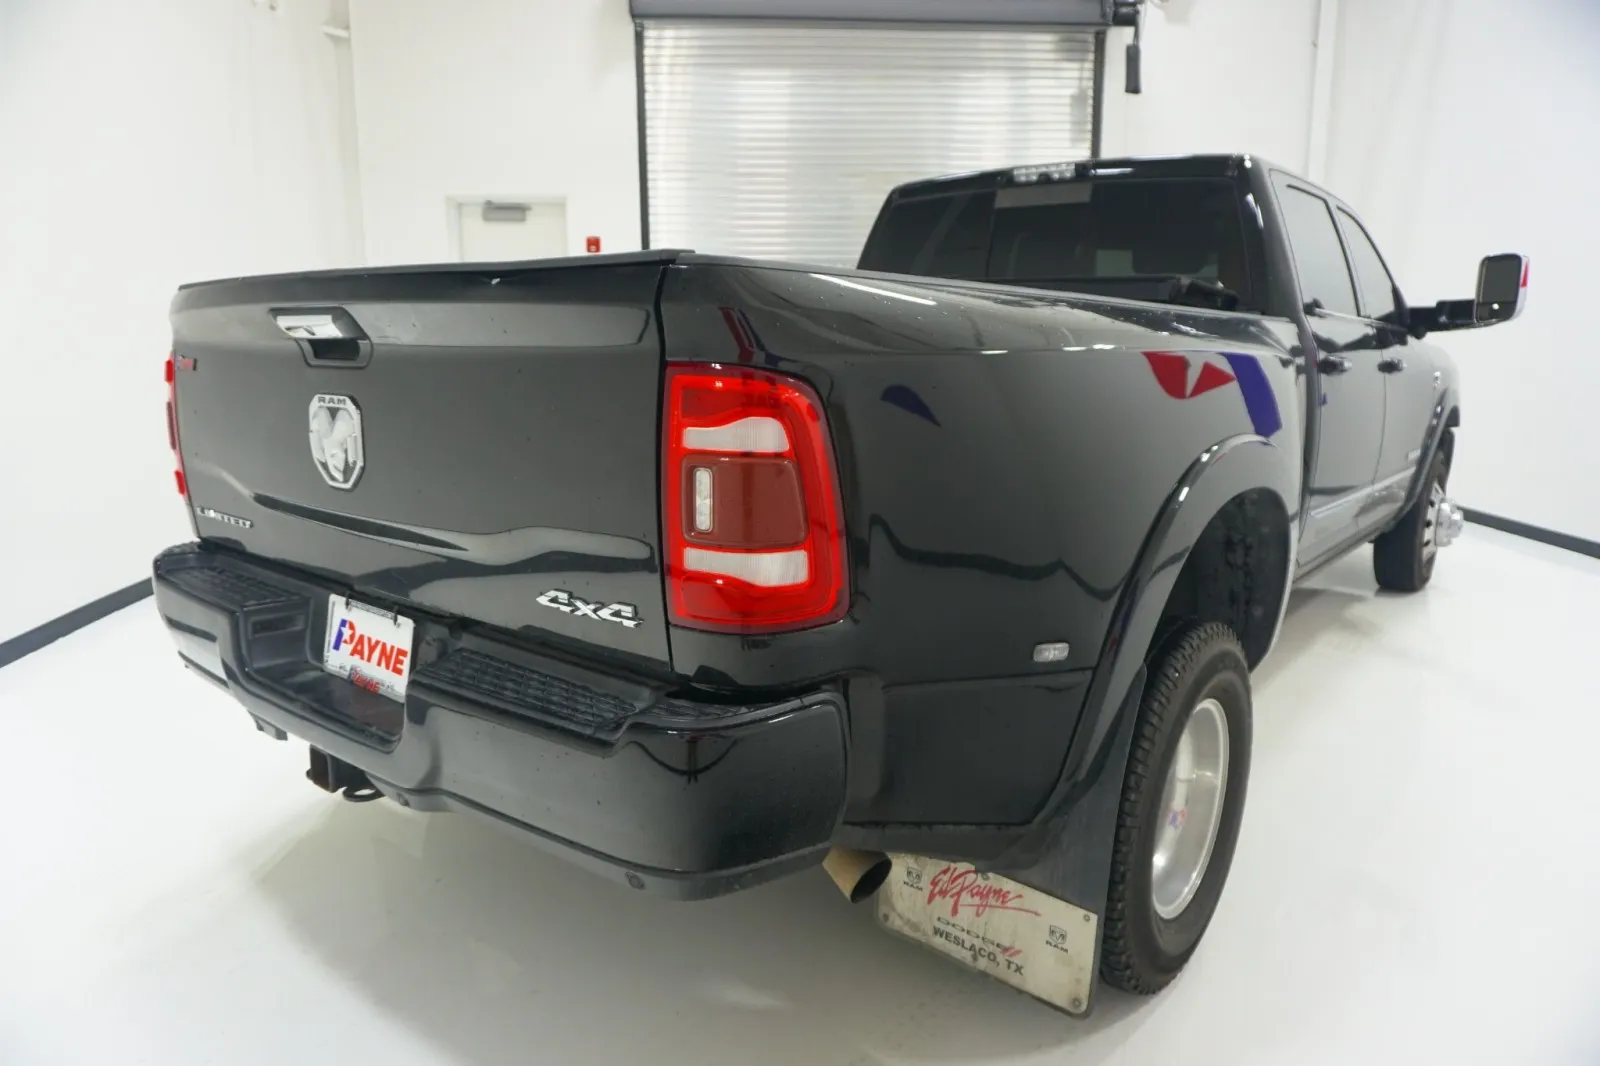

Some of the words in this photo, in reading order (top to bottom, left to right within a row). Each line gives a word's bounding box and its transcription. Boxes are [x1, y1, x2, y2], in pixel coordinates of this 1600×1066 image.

[317, 395, 347, 406] RAM
[196, 506, 252, 529] LIMITED
[332, 618, 409, 676] PAYNE
[927, 864, 957, 905] Ed
[949, 869, 1030, 918] Payne
[933, 925, 1000, 967] WESLACO,
[1004, 958, 1025, 976] TX
[1045, 939, 1069, 954] RAM
